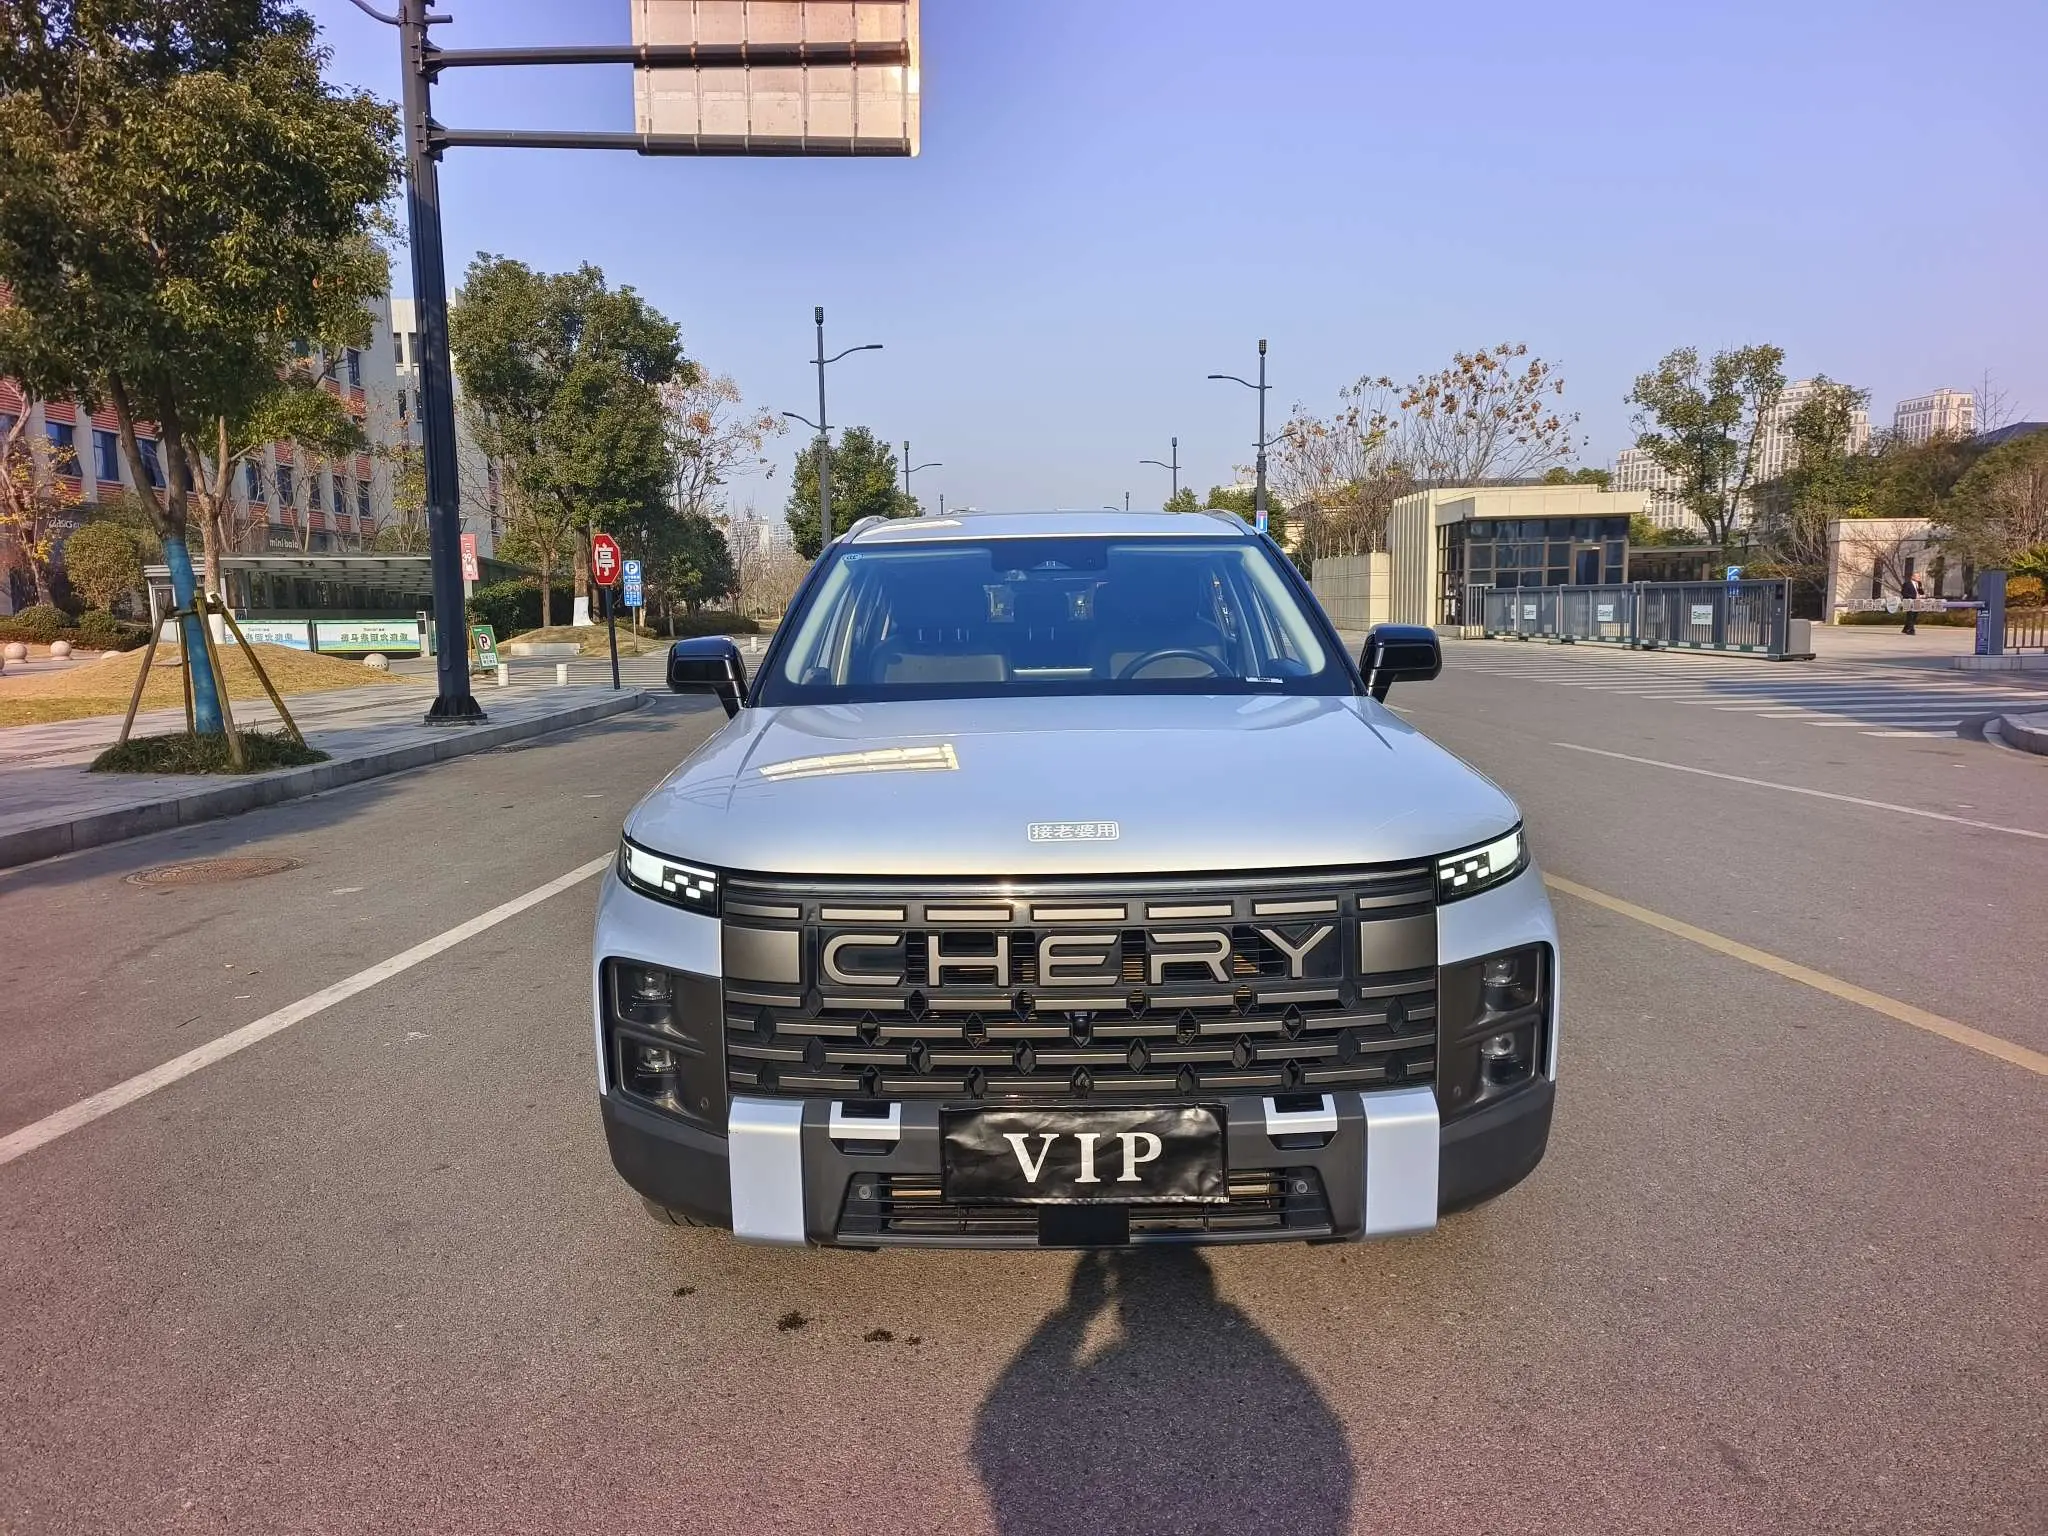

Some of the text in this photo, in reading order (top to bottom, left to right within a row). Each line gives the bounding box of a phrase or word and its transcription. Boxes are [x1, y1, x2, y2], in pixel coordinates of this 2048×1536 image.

[269, 538, 284, 548] mini
[594, 542, 615, 577] 停
[628, 563, 636, 573] P
[480, 635, 488, 649] P
[1032, 823, 1116, 840] 接老婆用
[822, 925, 1334, 987] CHERY
[1002, 1131, 1163, 1184] VIP
